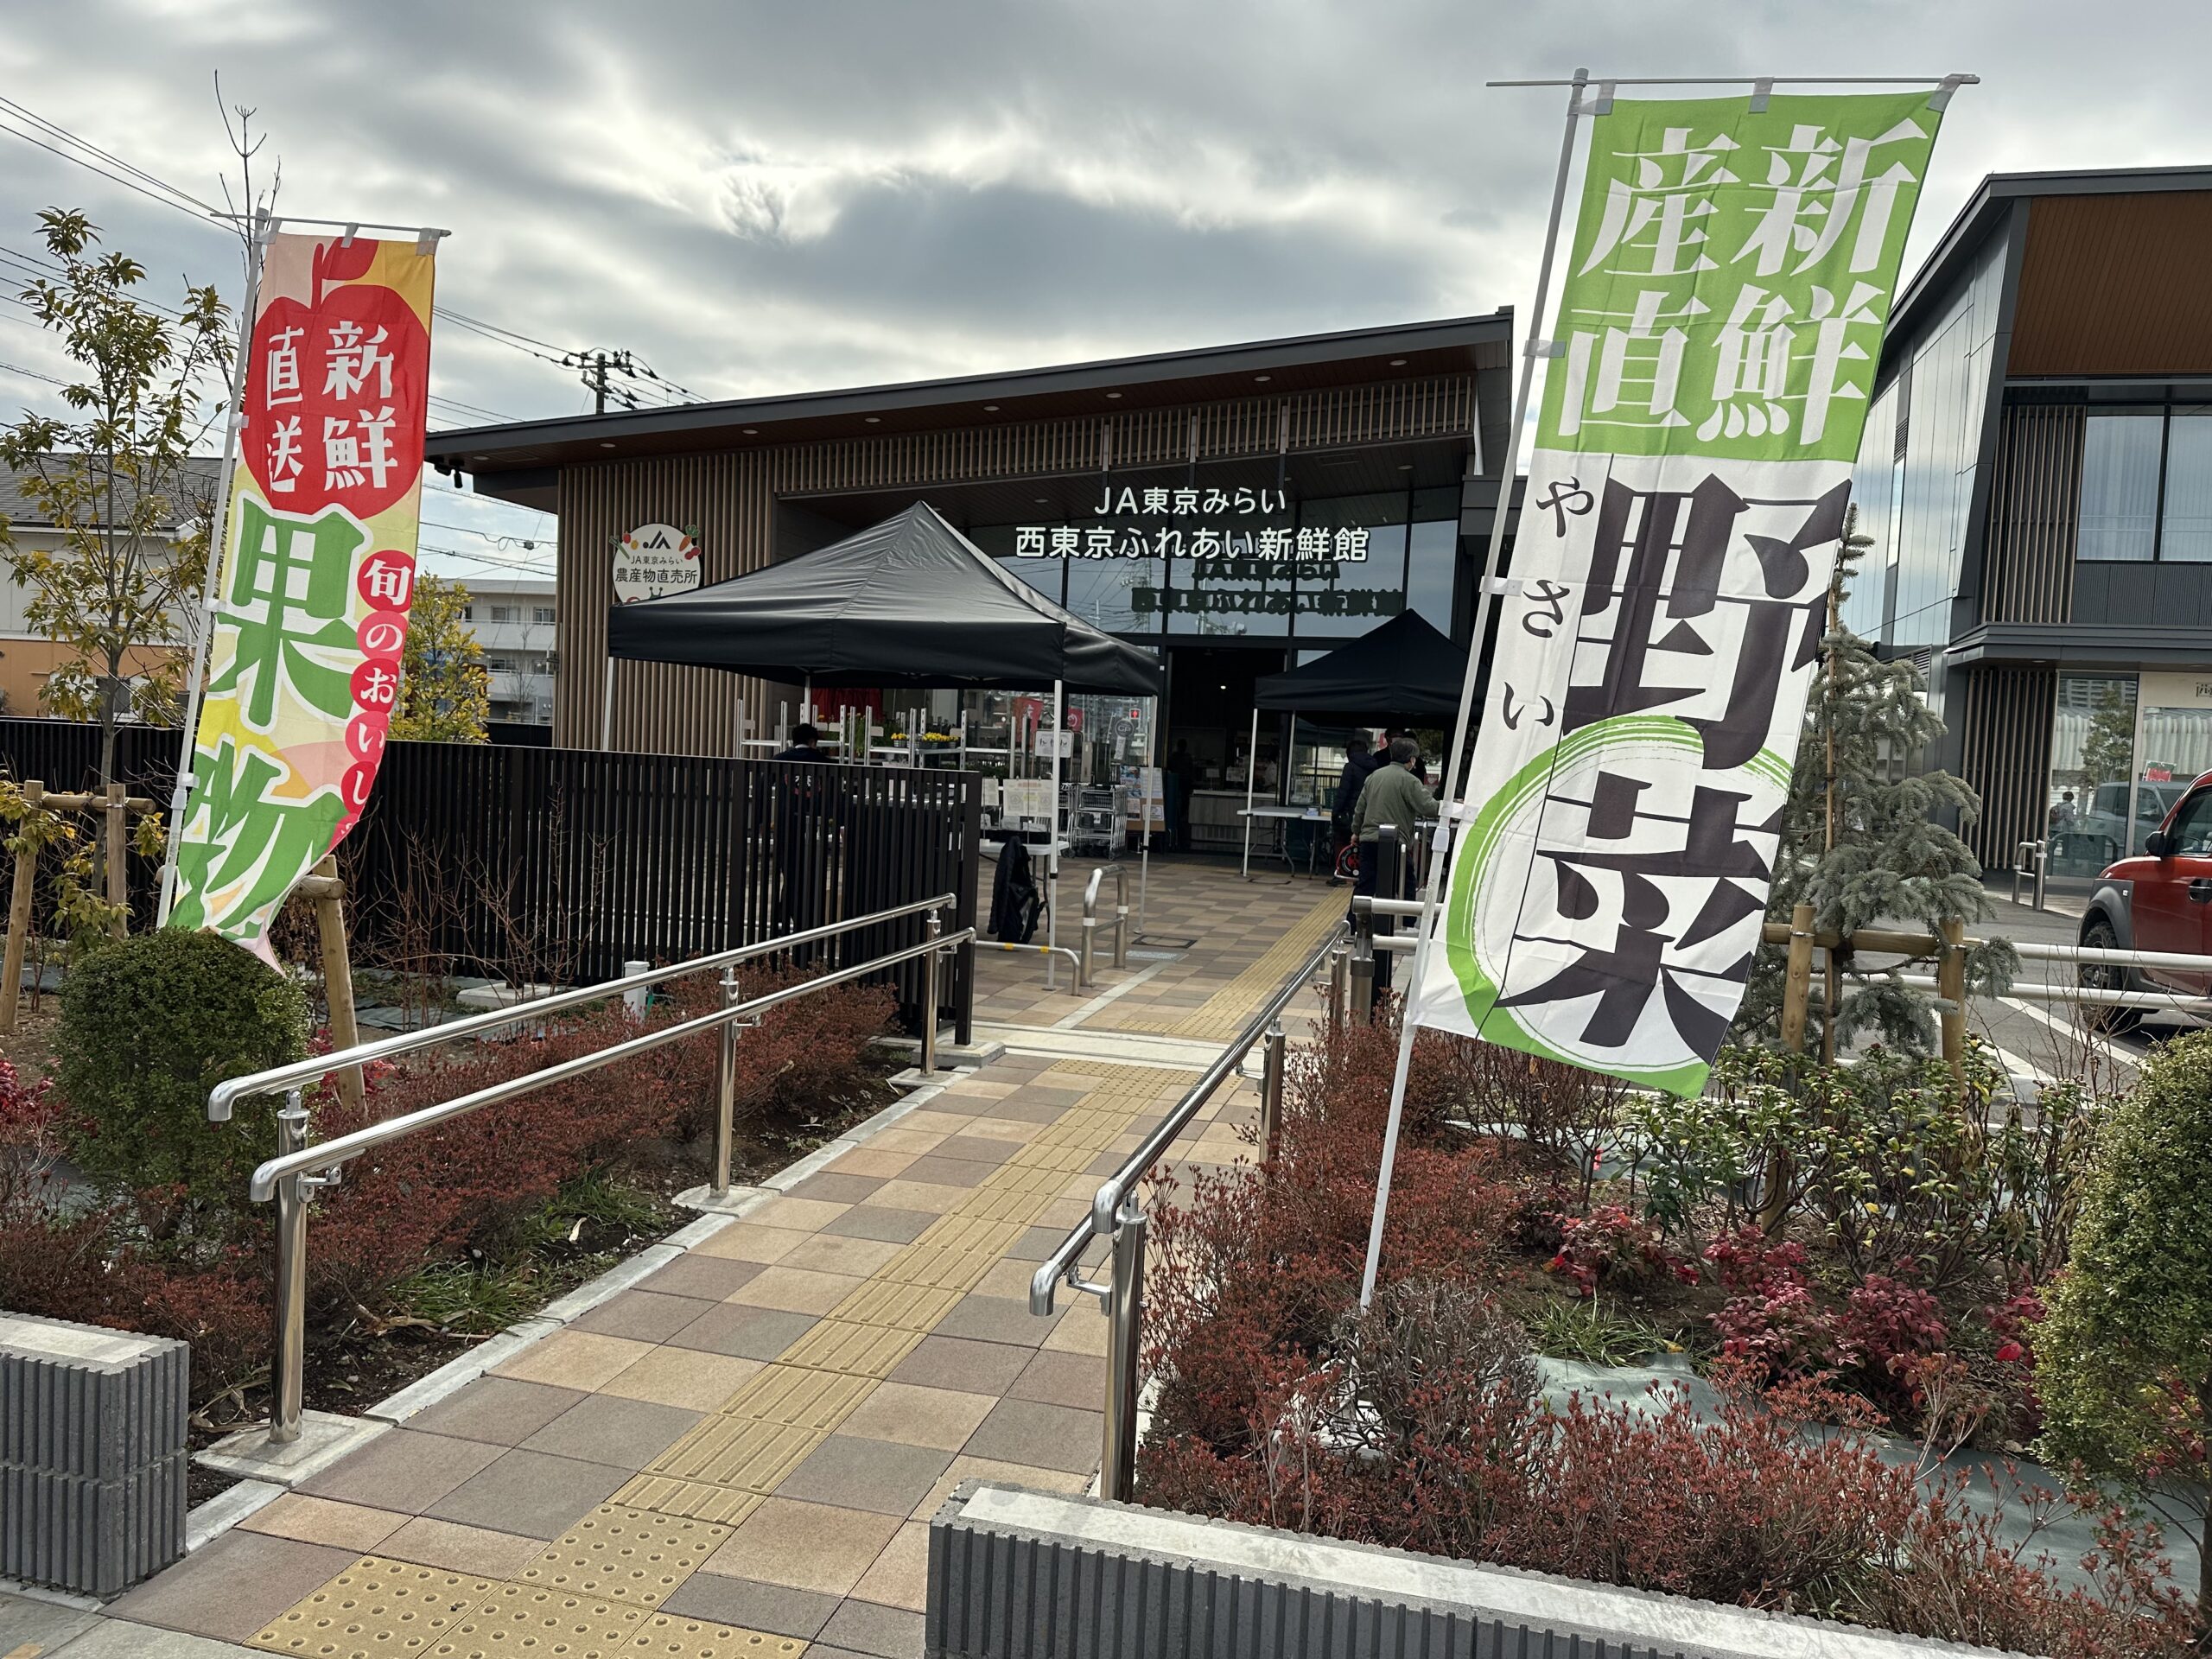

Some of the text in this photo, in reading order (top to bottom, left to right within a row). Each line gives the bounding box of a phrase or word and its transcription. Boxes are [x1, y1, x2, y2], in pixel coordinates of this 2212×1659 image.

[1558, 127, 1742, 436] 産直
[1696, 118, 1929, 446] 新鮮
[265, 325, 305, 493] 直送
[321, 321, 398, 491] 新鮮
[614, 567, 698, 584] 農産物直売所
[631, 556, 683, 566] JA東京みらい
[1014, 525, 1370, 563] 西東京ふれあい新鮮館
[1094, 486, 1287, 516] JA東京みらい
[1502, 476, 1594, 731] やさい
[340, 559, 412, 835] 旬のおいし
[1493, 473, 1852, 1067] 野菜
